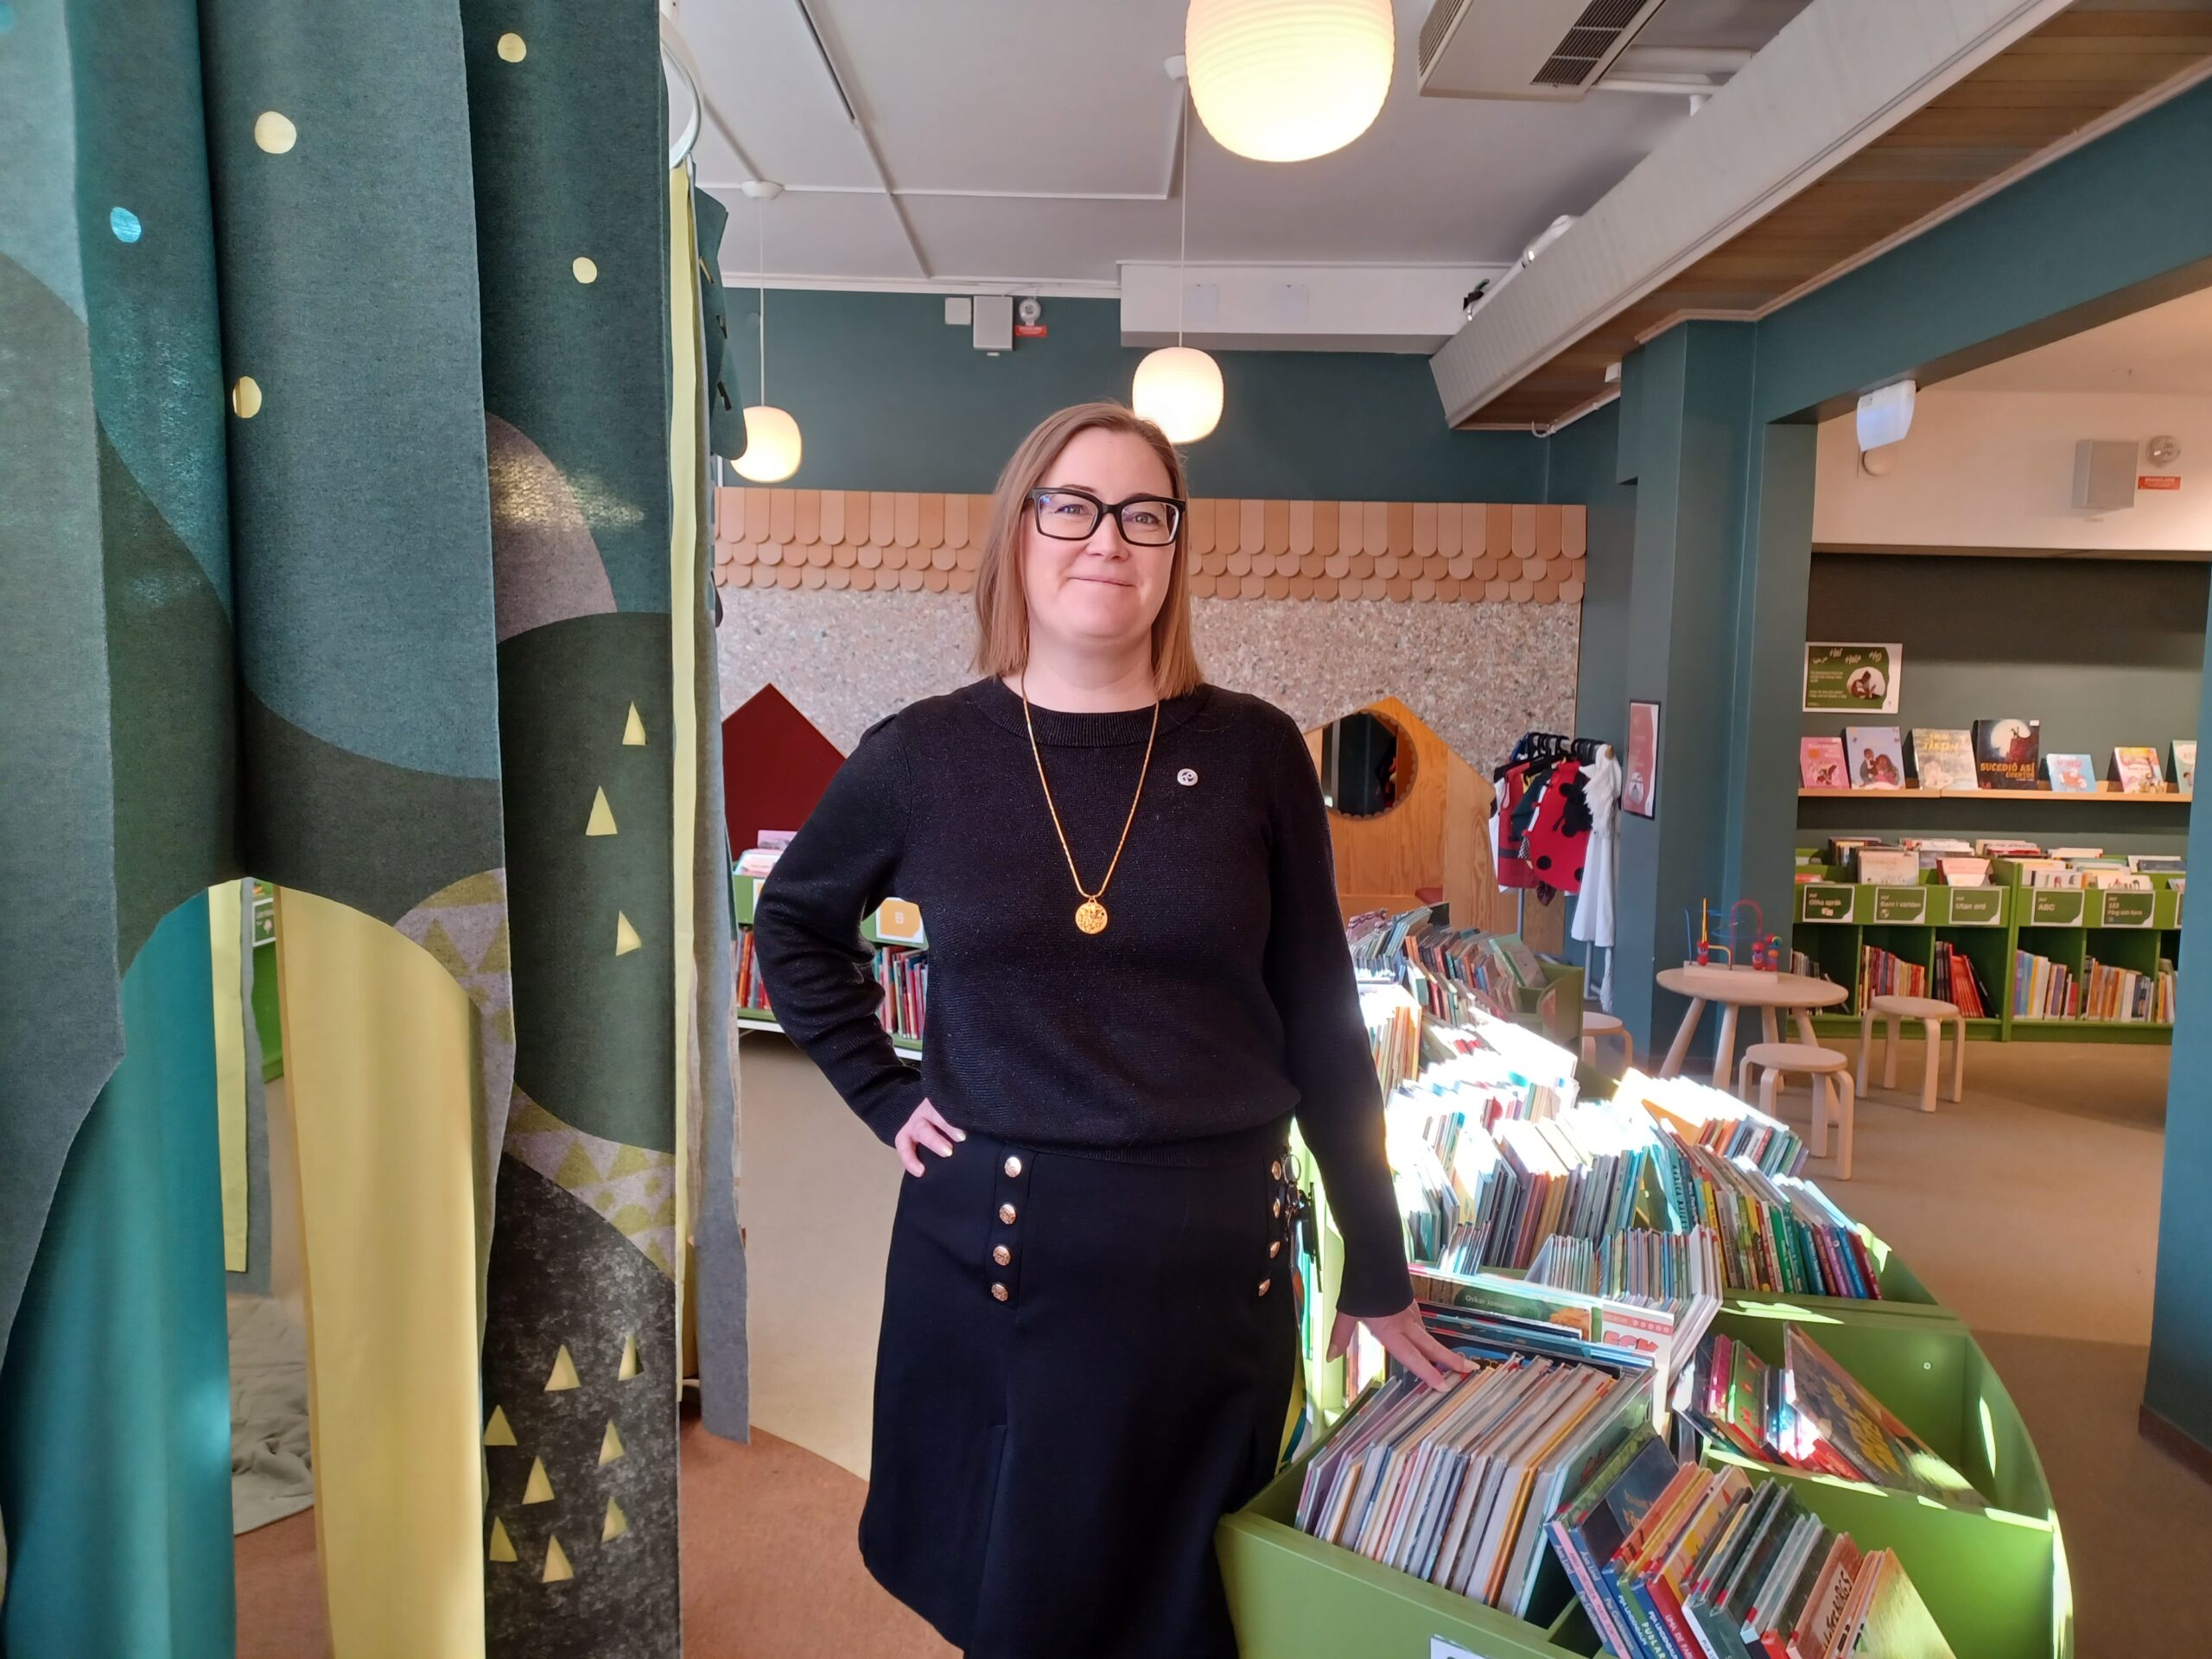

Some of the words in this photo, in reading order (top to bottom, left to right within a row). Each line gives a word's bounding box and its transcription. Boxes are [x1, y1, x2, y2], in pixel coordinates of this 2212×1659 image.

[1980, 762, 2018, 772] SUCEDIÓ
[1465, 1294, 1485, 1305] Oskar
[1561, 1559, 1574, 1575] Lind
[1588, 1566, 1601, 1581] Lind
[1618, 1594, 1627, 1607] PIJA
[1648, 1611, 1658, 1624] PIJA
